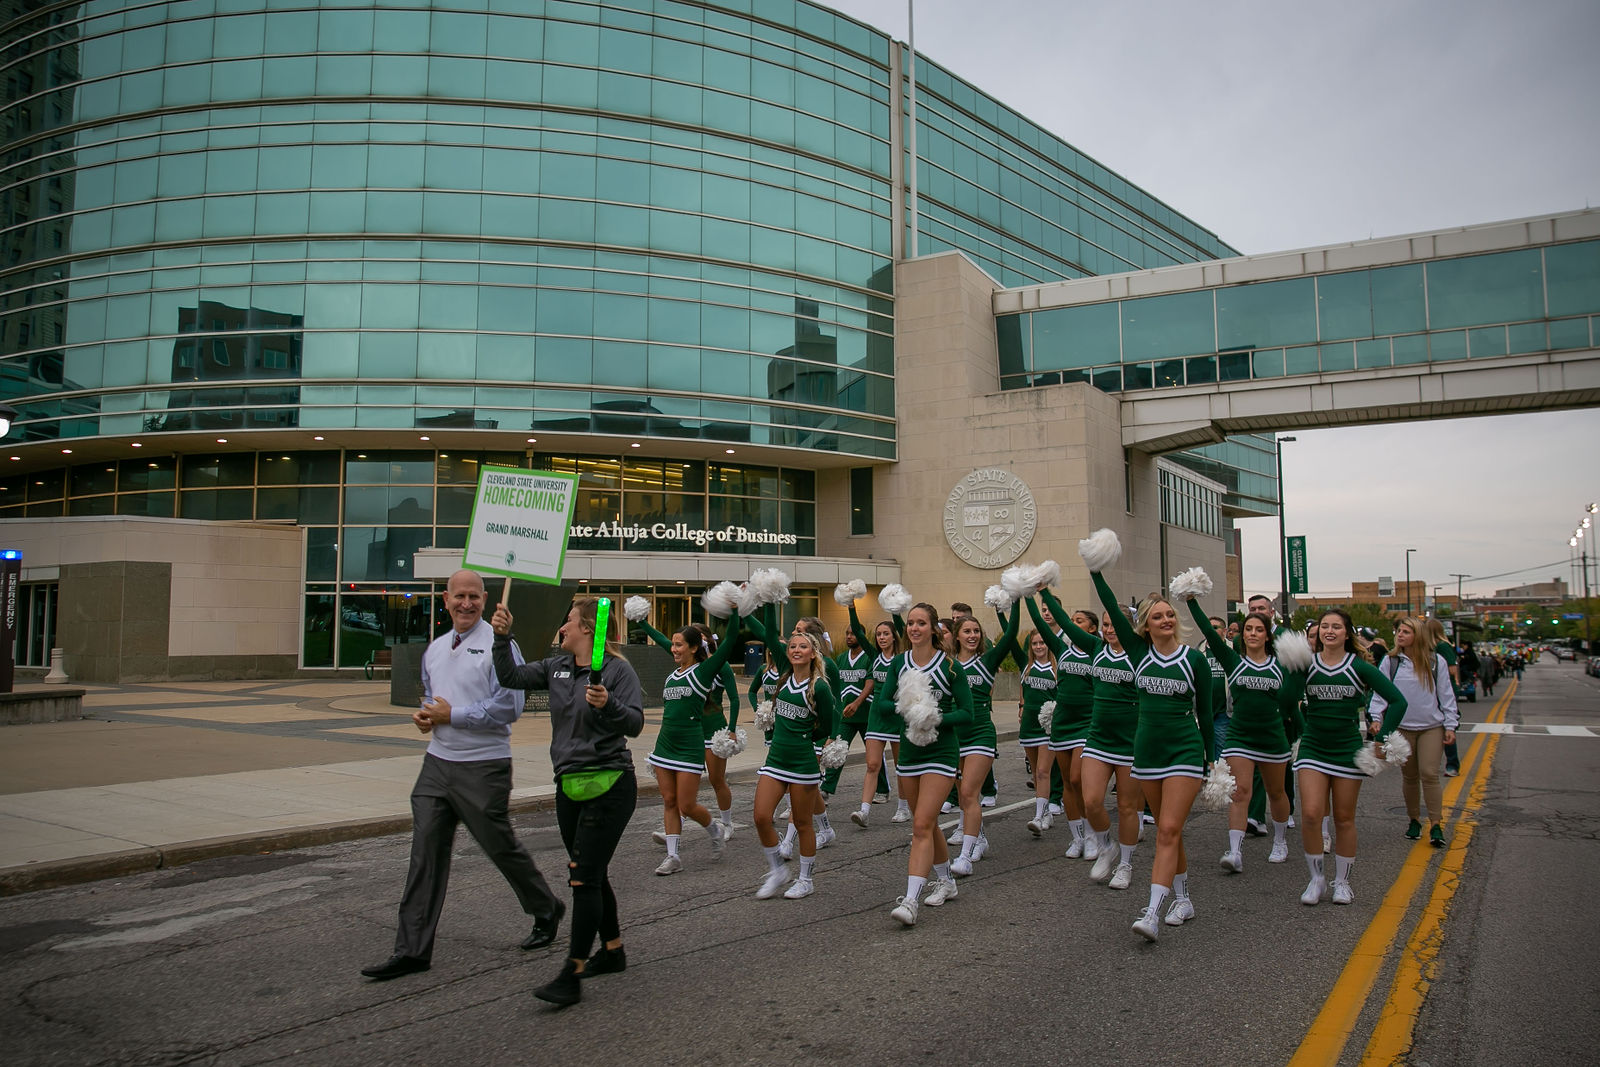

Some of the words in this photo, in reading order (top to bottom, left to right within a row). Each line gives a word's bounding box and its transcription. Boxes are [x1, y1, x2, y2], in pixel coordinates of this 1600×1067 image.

[486, 474, 517, 487] CLEVELAND
[516, 477, 533, 489] STATE
[533, 479, 568, 492] UNIVERSITY
[483, 485, 566, 513] HOMECOMING
[967, 469, 1007, 486] STATE
[1008, 478, 1035, 558] UNIVERSITY
[485, 522, 509, 535] GRAND
[509, 525, 549, 541] MARSHALL
[595, 520, 648, 543] Ahuja
[651, 522, 714, 546] College
[716, 525, 735, 542] of
[735, 526, 797, 545] Business
[978, 555, 1002, 568] 1964
[6, 573, 17, 630] EMERGENCY
[1137, 675, 1188, 694] CLEVELAND
[1147, 685, 1174, 696] STATE
